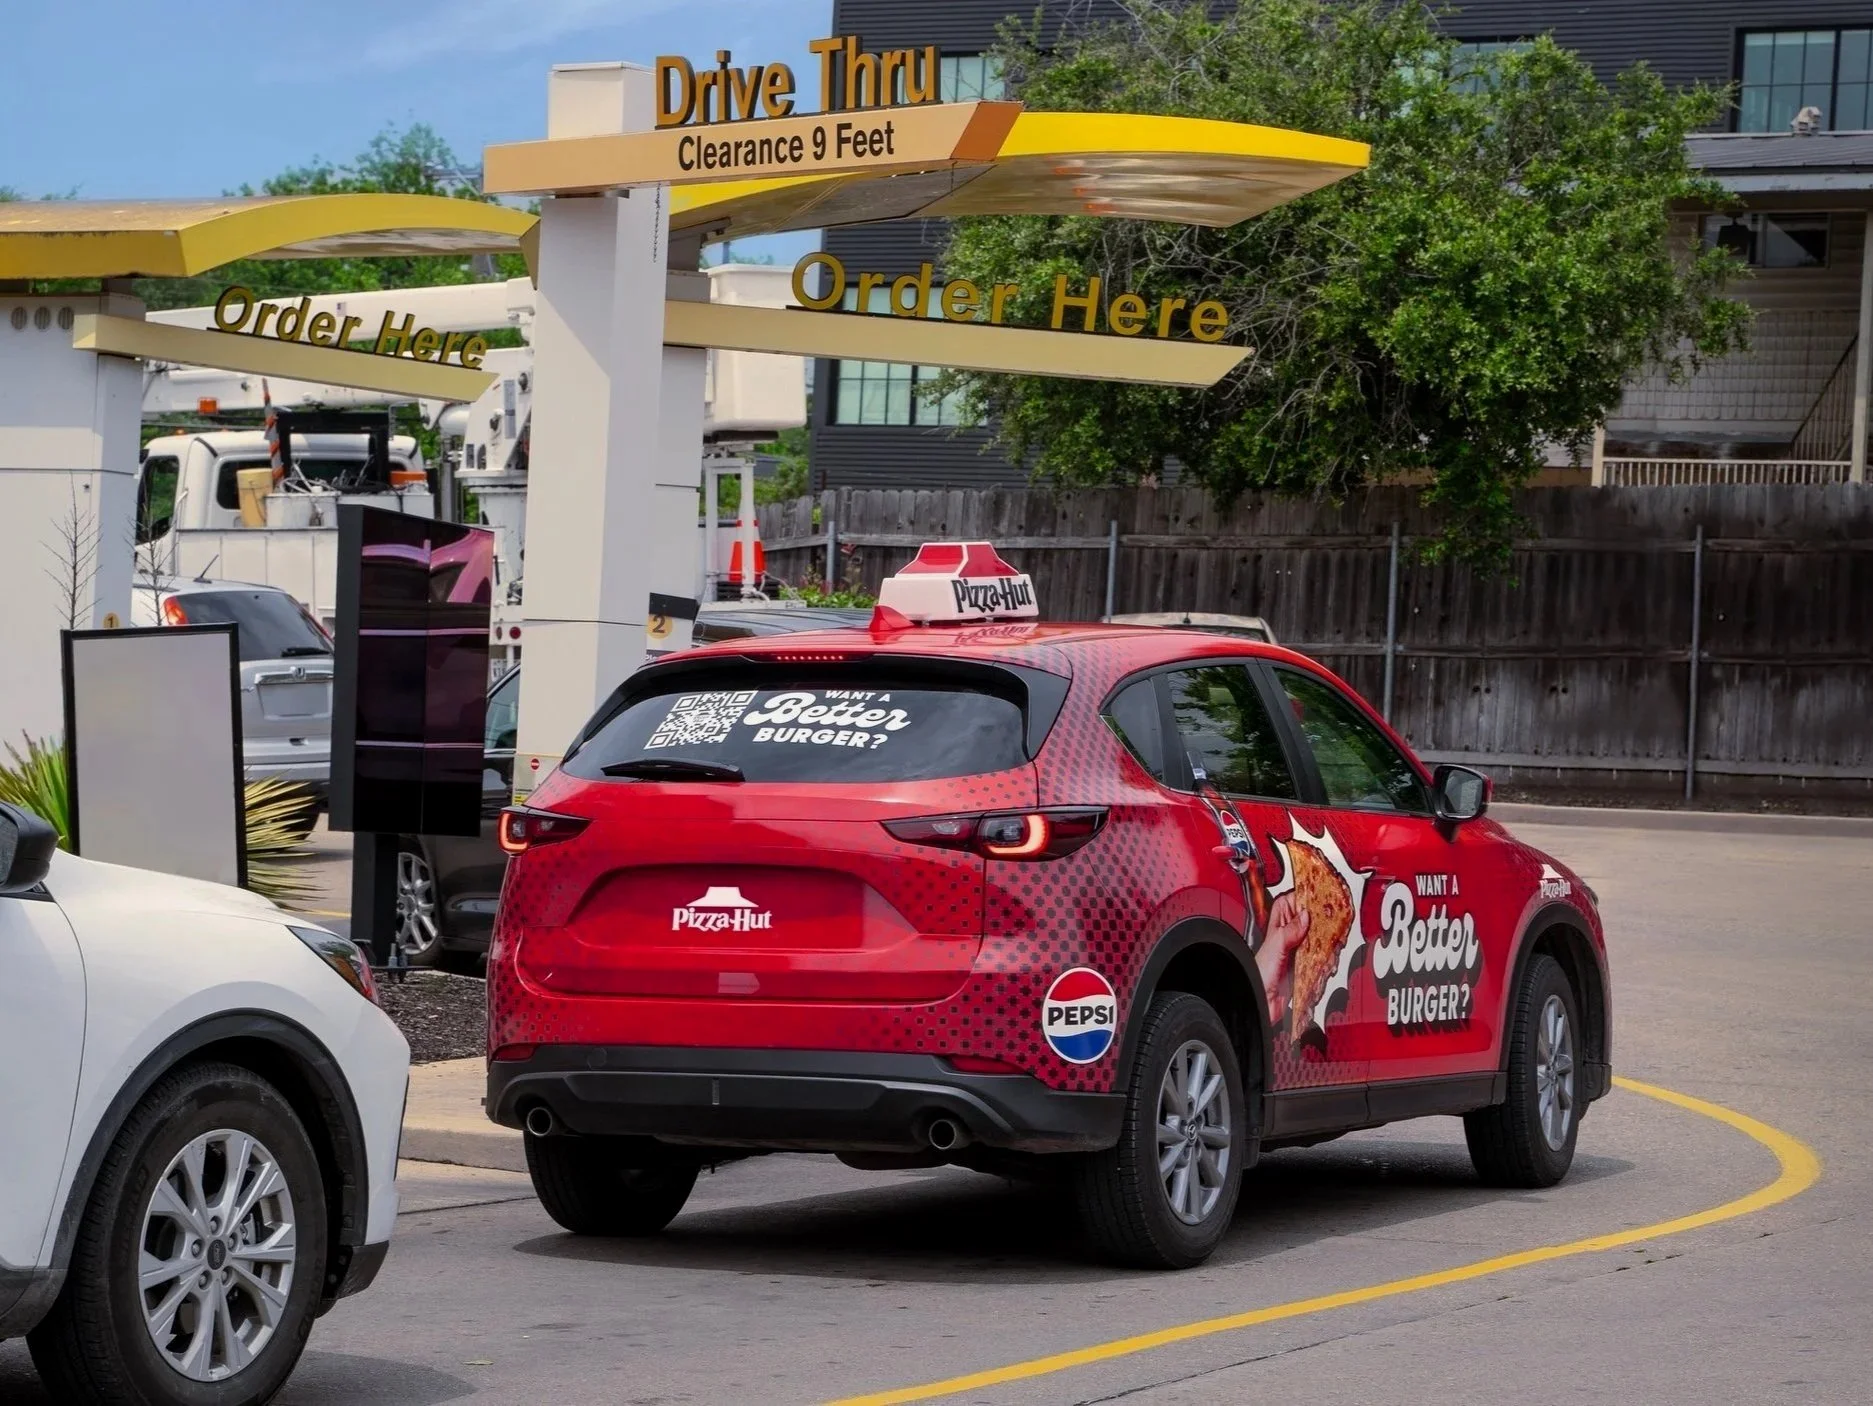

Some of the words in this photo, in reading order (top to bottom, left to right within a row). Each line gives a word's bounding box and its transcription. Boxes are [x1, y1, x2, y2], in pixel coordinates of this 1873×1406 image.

[656, 49, 796, 127] Drive
[809, 35, 942, 112] Thru
[678, 134, 804, 172] Clearance
[812, 126, 826, 160] 9
[837, 120, 895, 158] Feet
[791, 251, 1018, 324] Order
[1051, 274, 1229, 342] Here
[214, 285, 363, 348] Order
[374, 310, 488, 369] Here
[652, 614, 665, 633] 2
[743, 692, 911, 731] Better
[825, 690, 876, 702] WANT
[877, 693, 890, 702] A
[753, 727, 888, 749] BURGER?
[1415, 874, 1448, 896] WANT
[1451, 874, 1459, 895] A
[1373, 882, 1479, 979] Better
[1048, 1005, 1114, 1026] PEPSI
[1388, 984, 1470, 1025] BURGER?
